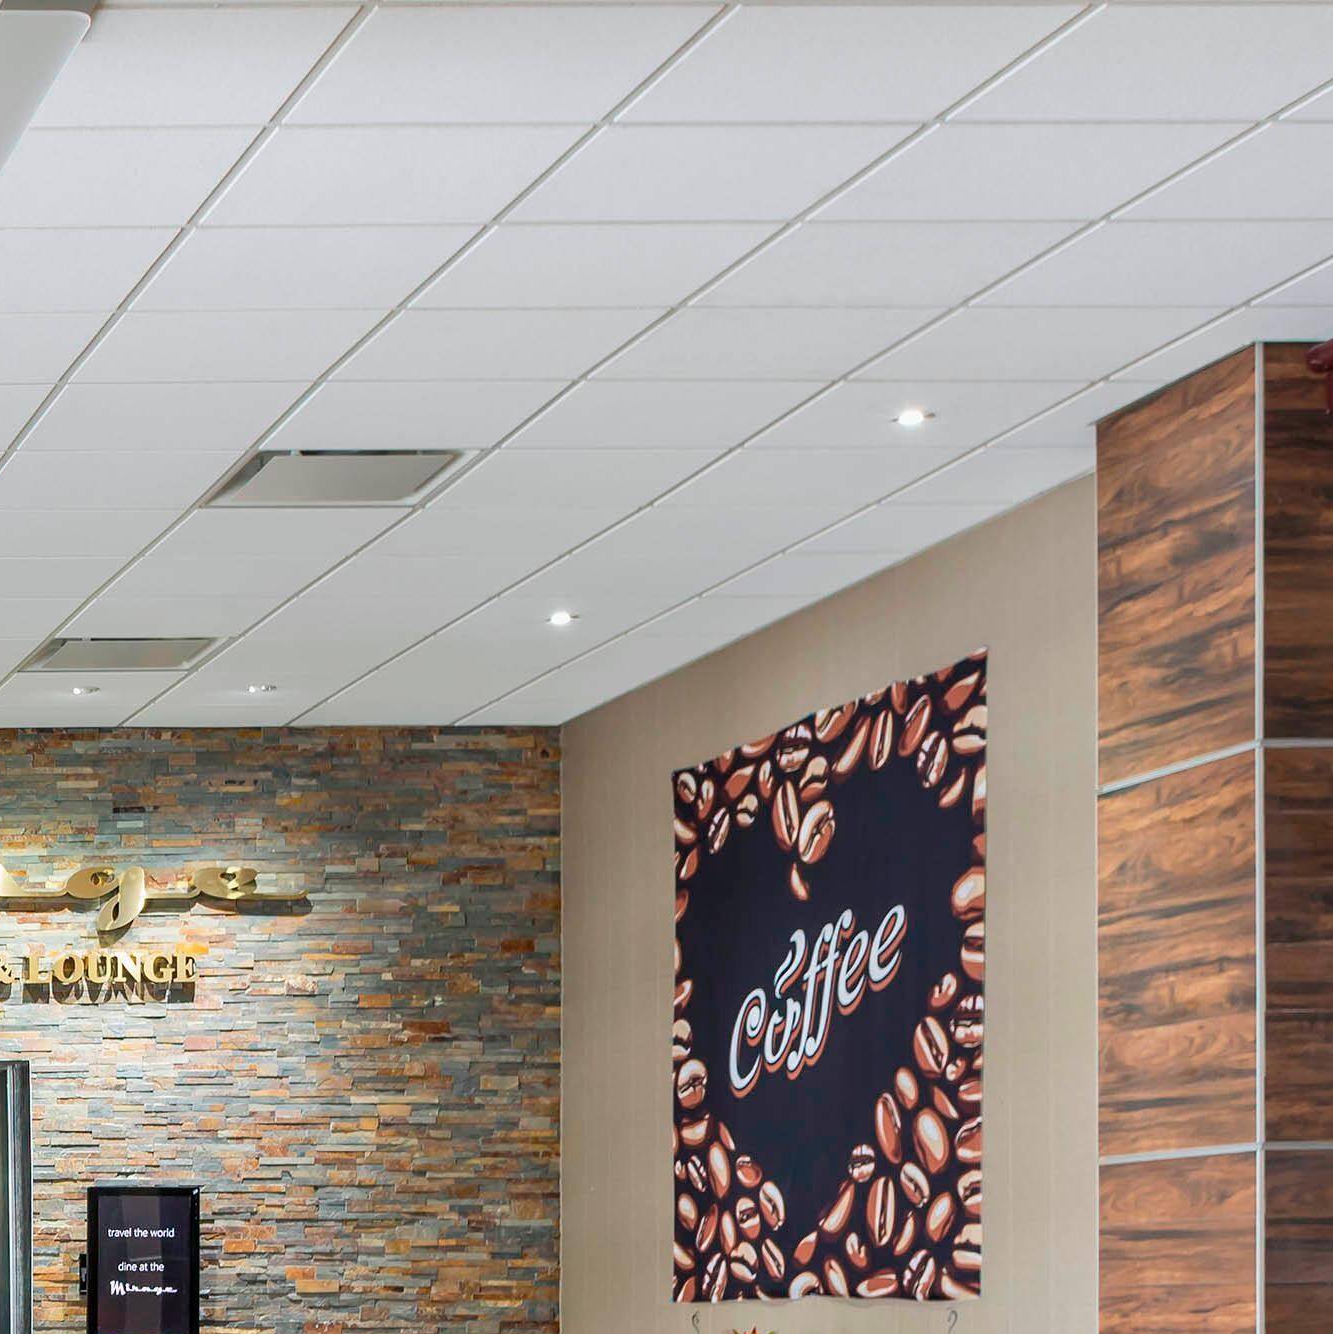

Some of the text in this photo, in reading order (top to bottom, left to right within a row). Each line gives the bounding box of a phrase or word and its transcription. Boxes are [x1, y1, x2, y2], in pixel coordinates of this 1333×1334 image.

[23, 952, 198, 985] LOUNGE
[729, 903, 908, 1099] Coffee
[108, 1228, 175, 1238] travel the world
[118, 1262, 165, 1272] dine at the
